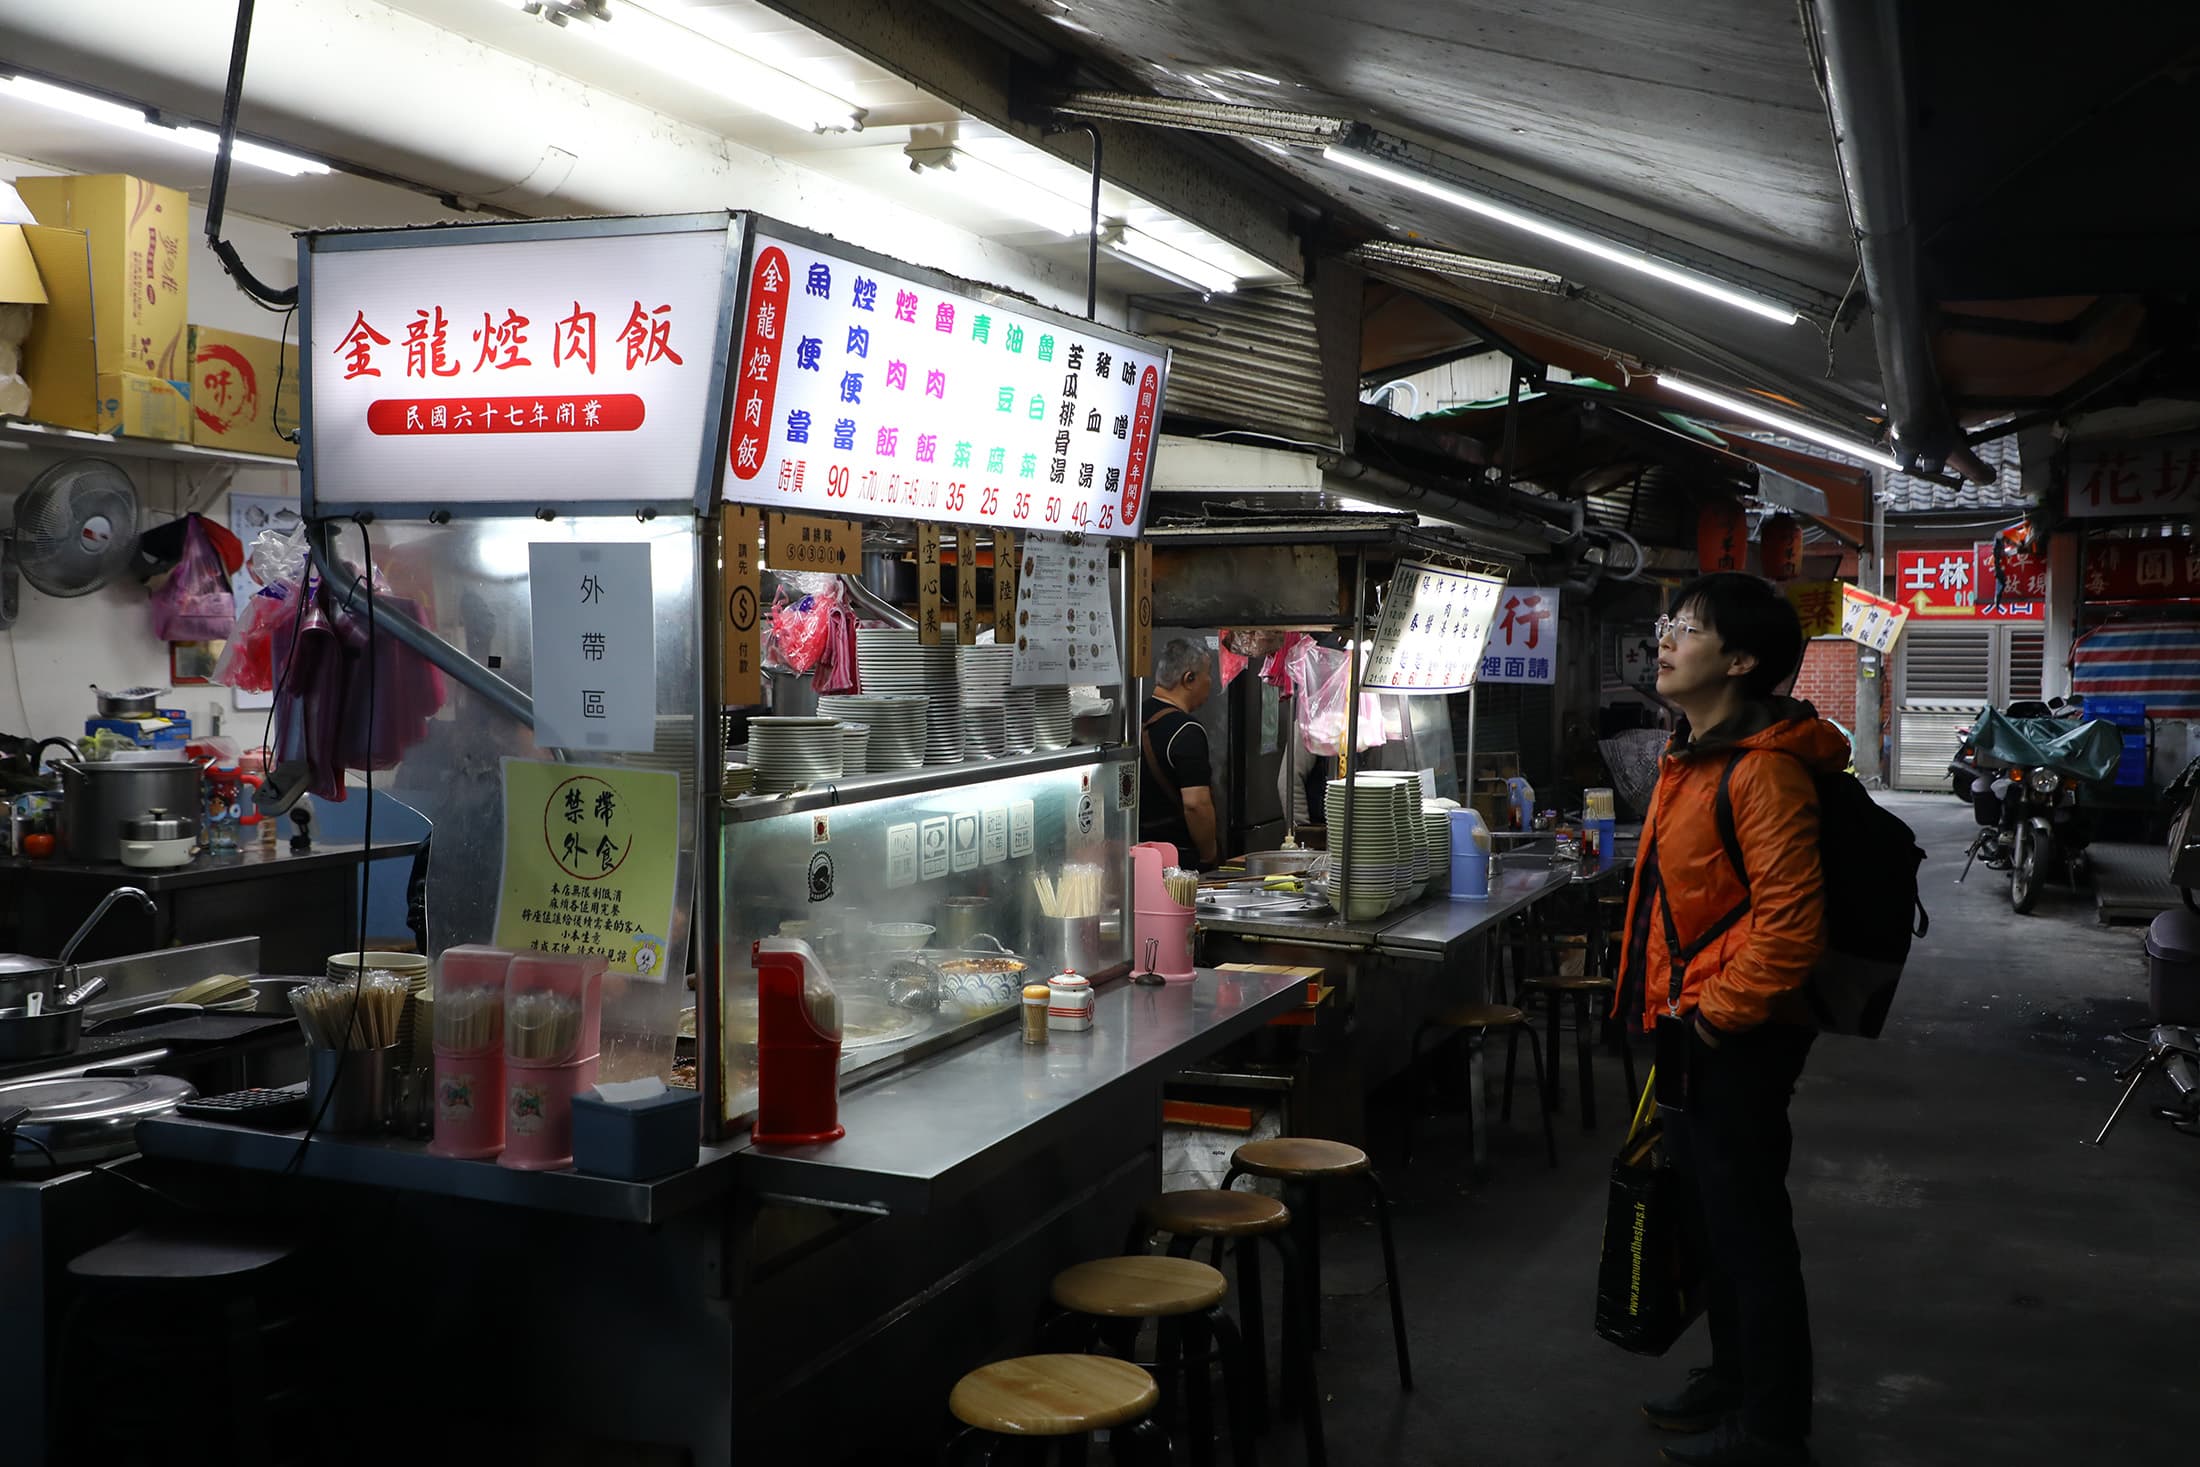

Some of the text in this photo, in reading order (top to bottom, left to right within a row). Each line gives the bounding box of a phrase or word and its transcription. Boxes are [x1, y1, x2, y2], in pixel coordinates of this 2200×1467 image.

[333, 300, 684, 380] 金龍焢肉飯
[737, 256, 783, 470] 金龍焢肉飯
[787, 262, 832, 444] 魚便當
[834, 275, 877, 451] 焢肉便當
[876, 288, 918, 457] 焢肉飯
[916, 301, 956, 464] 魯肉飯
[406, 400, 603, 431] 民國六十七年開業
[954, 313, 991, 469] 青菜
[987, 322, 1023, 473] 油豆腐
[1021, 333, 1055, 479] 魯白菜
[1050, 343, 1085, 484] 苦瓜排骨湯
[1079, 350, 1112, 488] 豬血湯
[1104, 359, 1137, 493] 味噌湯
[778, 459, 807, 493] 時價
[827, 465, 850, 497] 90
[1123, 372, 1156, 519] 民國六十七年開業
[946, 482, 967, 512] 35
[980, 487, 1000, 516] 25
[1013, 492, 1031, 519] 35
[1045, 496, 1062, 524] 50
[1071, 501, 1088, 527] 40
[1098, 504, 1115, 530] 25
[921, 540, 939, 633] 空心菜
[960, 548, 974, 634] 地瓜葉
[999, 548, 1014, 632] 大陸妹
[1904, 556, 1970, 590] 士林
[580, 574, 606, 719] 外帶區
[1481, 657, 1549, 679] 裡面請
[562, 832, 619, 871] 外食
[1629, 1201, 1647, 1317] www.avenueofthestars.fr
